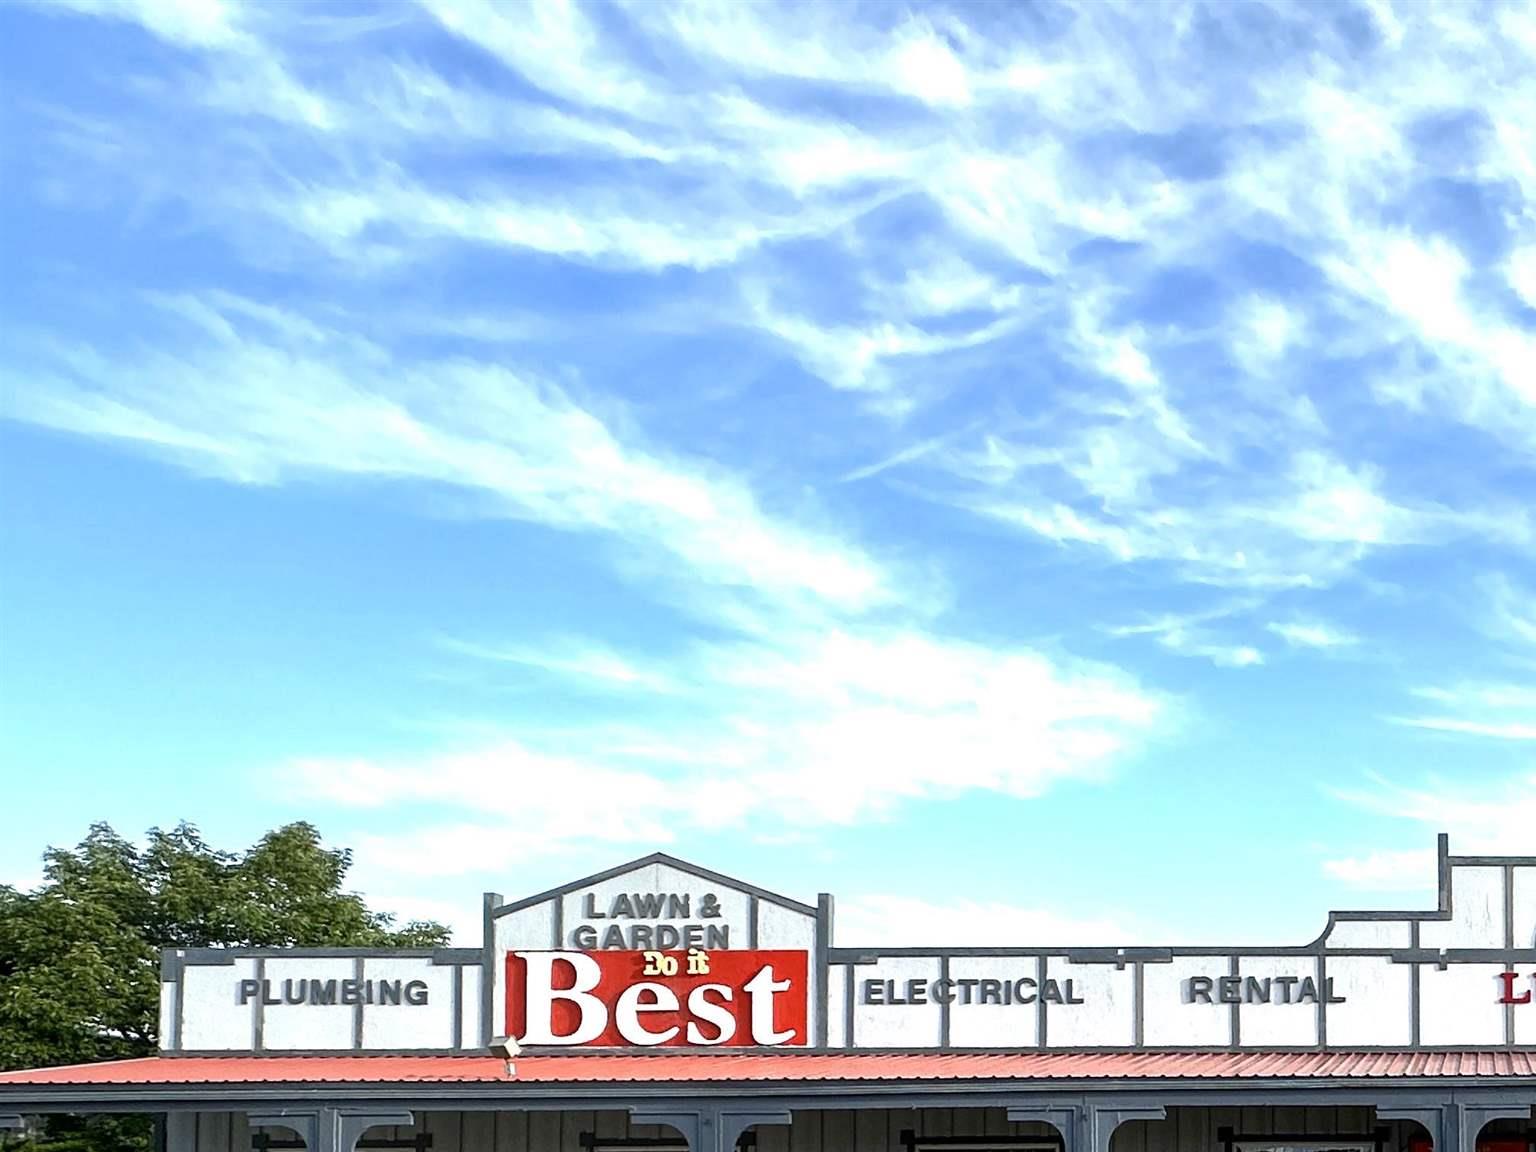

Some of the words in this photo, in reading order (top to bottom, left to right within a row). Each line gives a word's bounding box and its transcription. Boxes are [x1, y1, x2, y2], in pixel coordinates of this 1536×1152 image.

[586, 893, 690, 919] LAWN
[699, 893, 722, 919] &
[571, 924, 729, 949] GARDEN
[643, 951, 678, 976] Do
[687, 948, 711, 975] it
[239, 978, 429, 1006] PLUMBING
[514, 951, 797, 1047] Best
[863, 977, 1085, 1006] ELECTRICAL
[1187, 975, 1347, 1004] RENTAL
